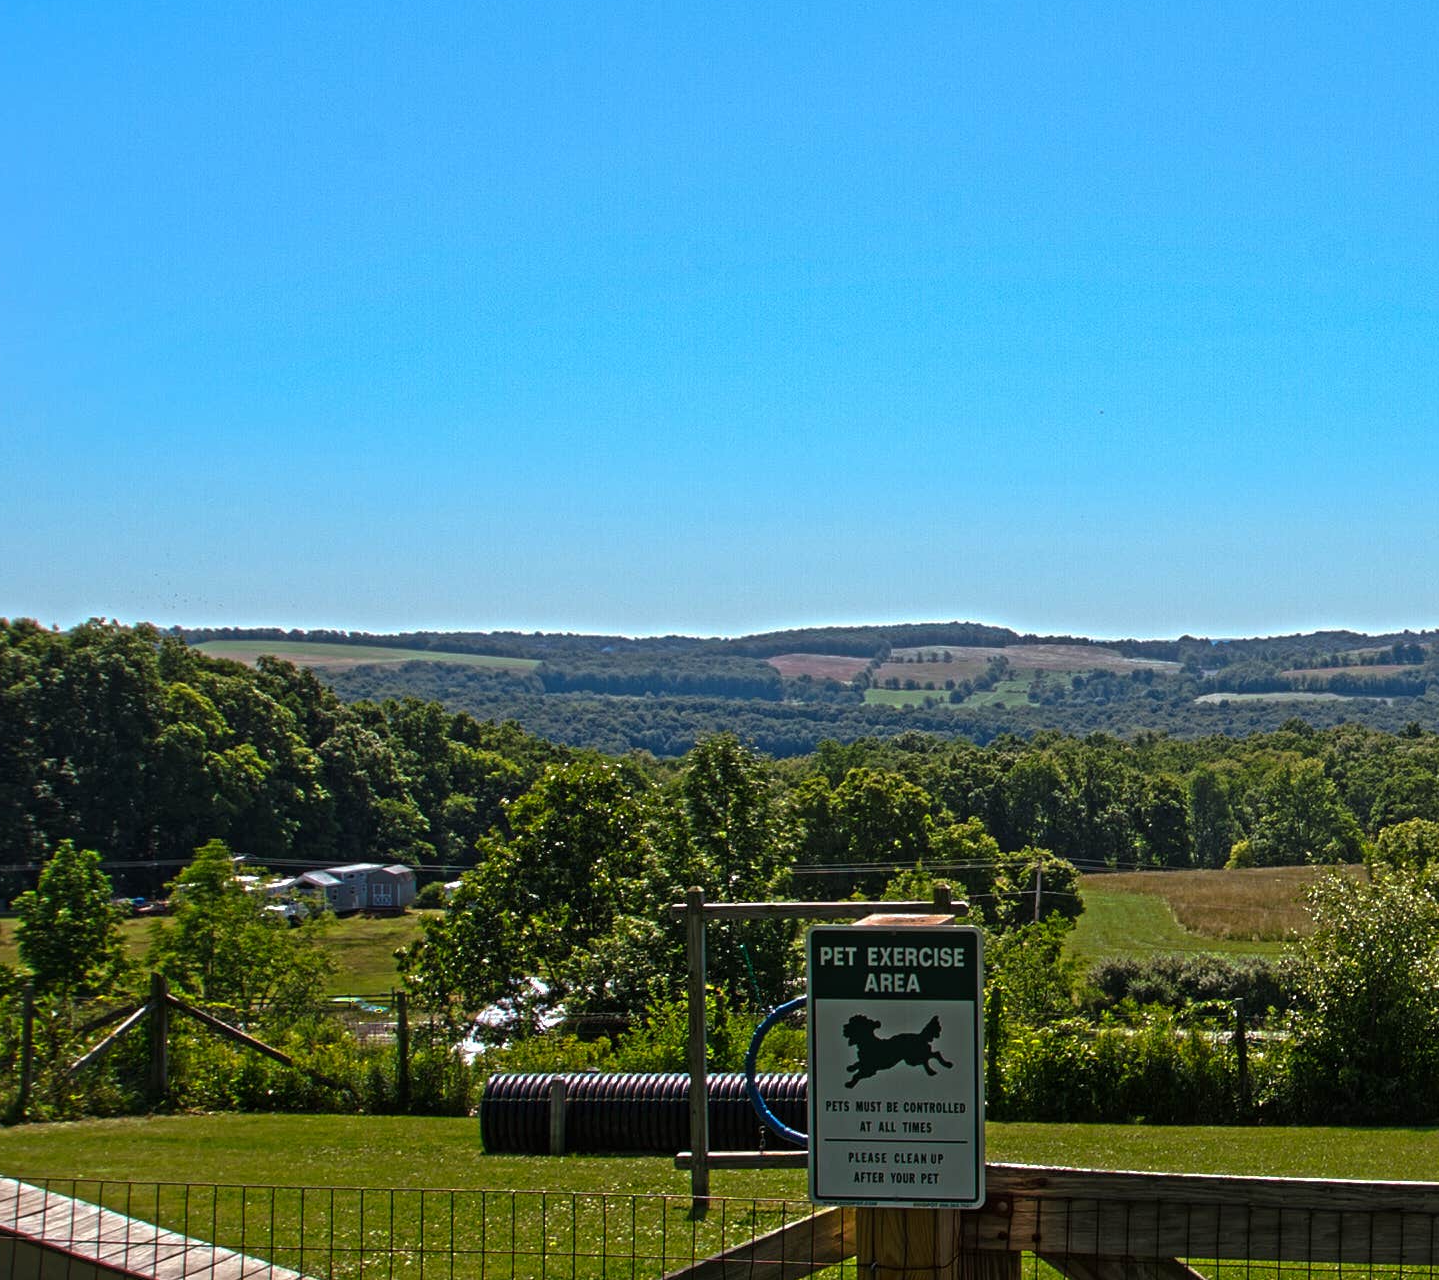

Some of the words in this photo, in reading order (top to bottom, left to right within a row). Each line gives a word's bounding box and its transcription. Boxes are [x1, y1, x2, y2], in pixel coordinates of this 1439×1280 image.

[820, 946, 857, 966] PET
[867, 947, 965, 967] EXERCISE
[864, 973, 921, 993] AREA
[825, 1100, 850, 1112] PETS
[855, 1101, 882, 1113] MUST
[886, 1101, 899, 1113] BE
[903, 1102, 966, 1114] CONTROLLED
[859, 1121, 871, 1133] AT
[878, 1121, 896, 1133] ALL
[902, 1121, 933, 1134] TIMES
[848, 1152, 887, 1164] PLEASE
[894, 1153, 927, 1164] CLEAN
[930, 1153, 944, 1165] UP
[853, 1172, 884, 1183] AFTER
[890, 1172, 915, 1184] YOUR
[921, 1173, 939, 1184] PET
